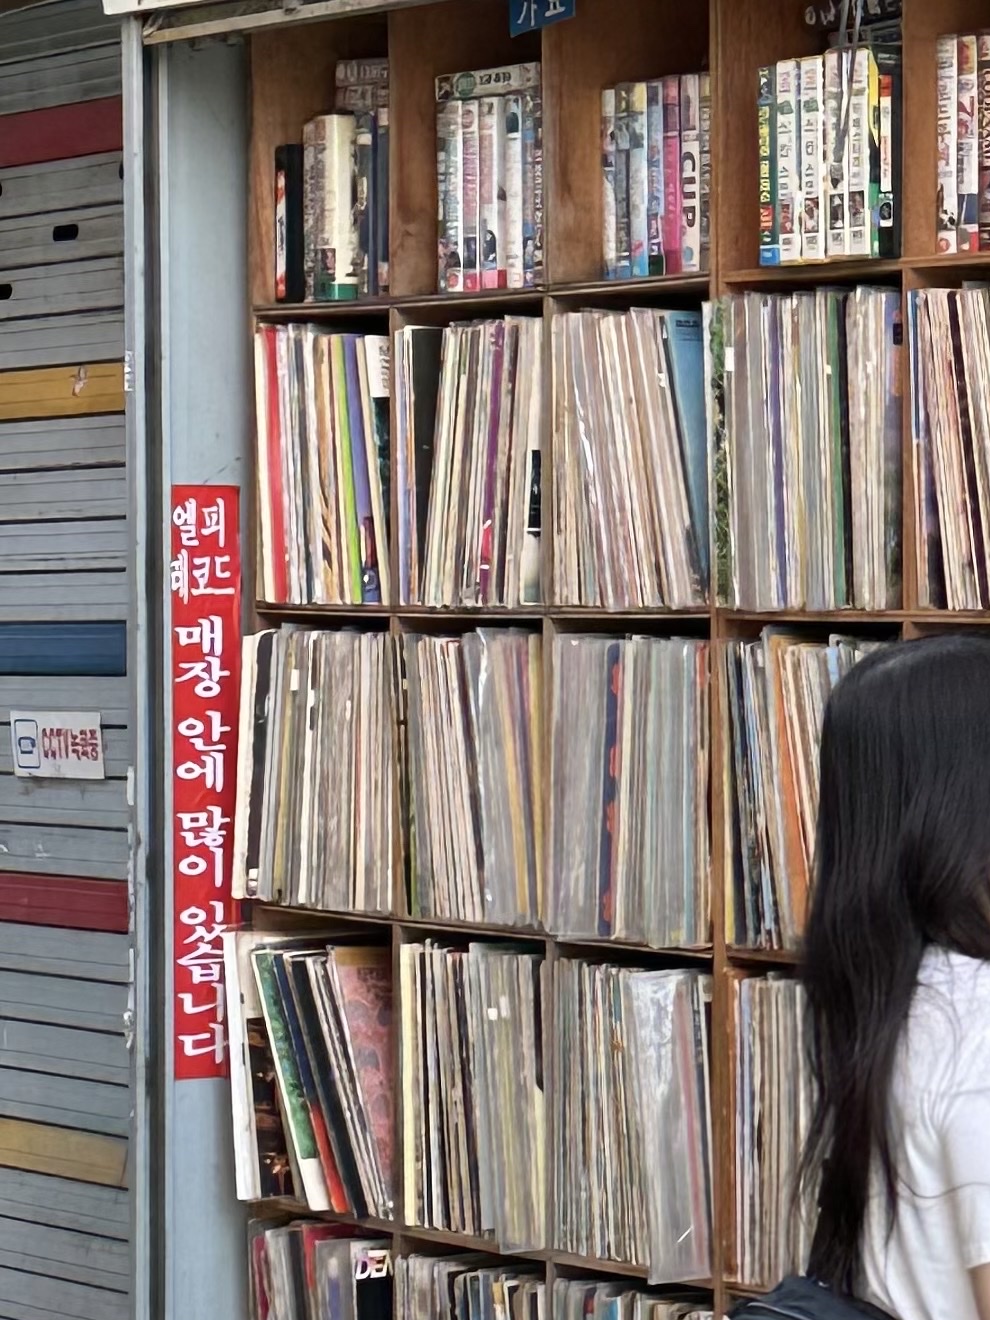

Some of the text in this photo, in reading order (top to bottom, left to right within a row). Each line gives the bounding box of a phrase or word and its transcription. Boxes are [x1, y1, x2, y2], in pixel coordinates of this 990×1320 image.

[173, 497, 225, 547] 엘피
[170, 548, 235, 605] 레코드
[174, 616, 230, 1065] 매장 안에 많이 있습니다
